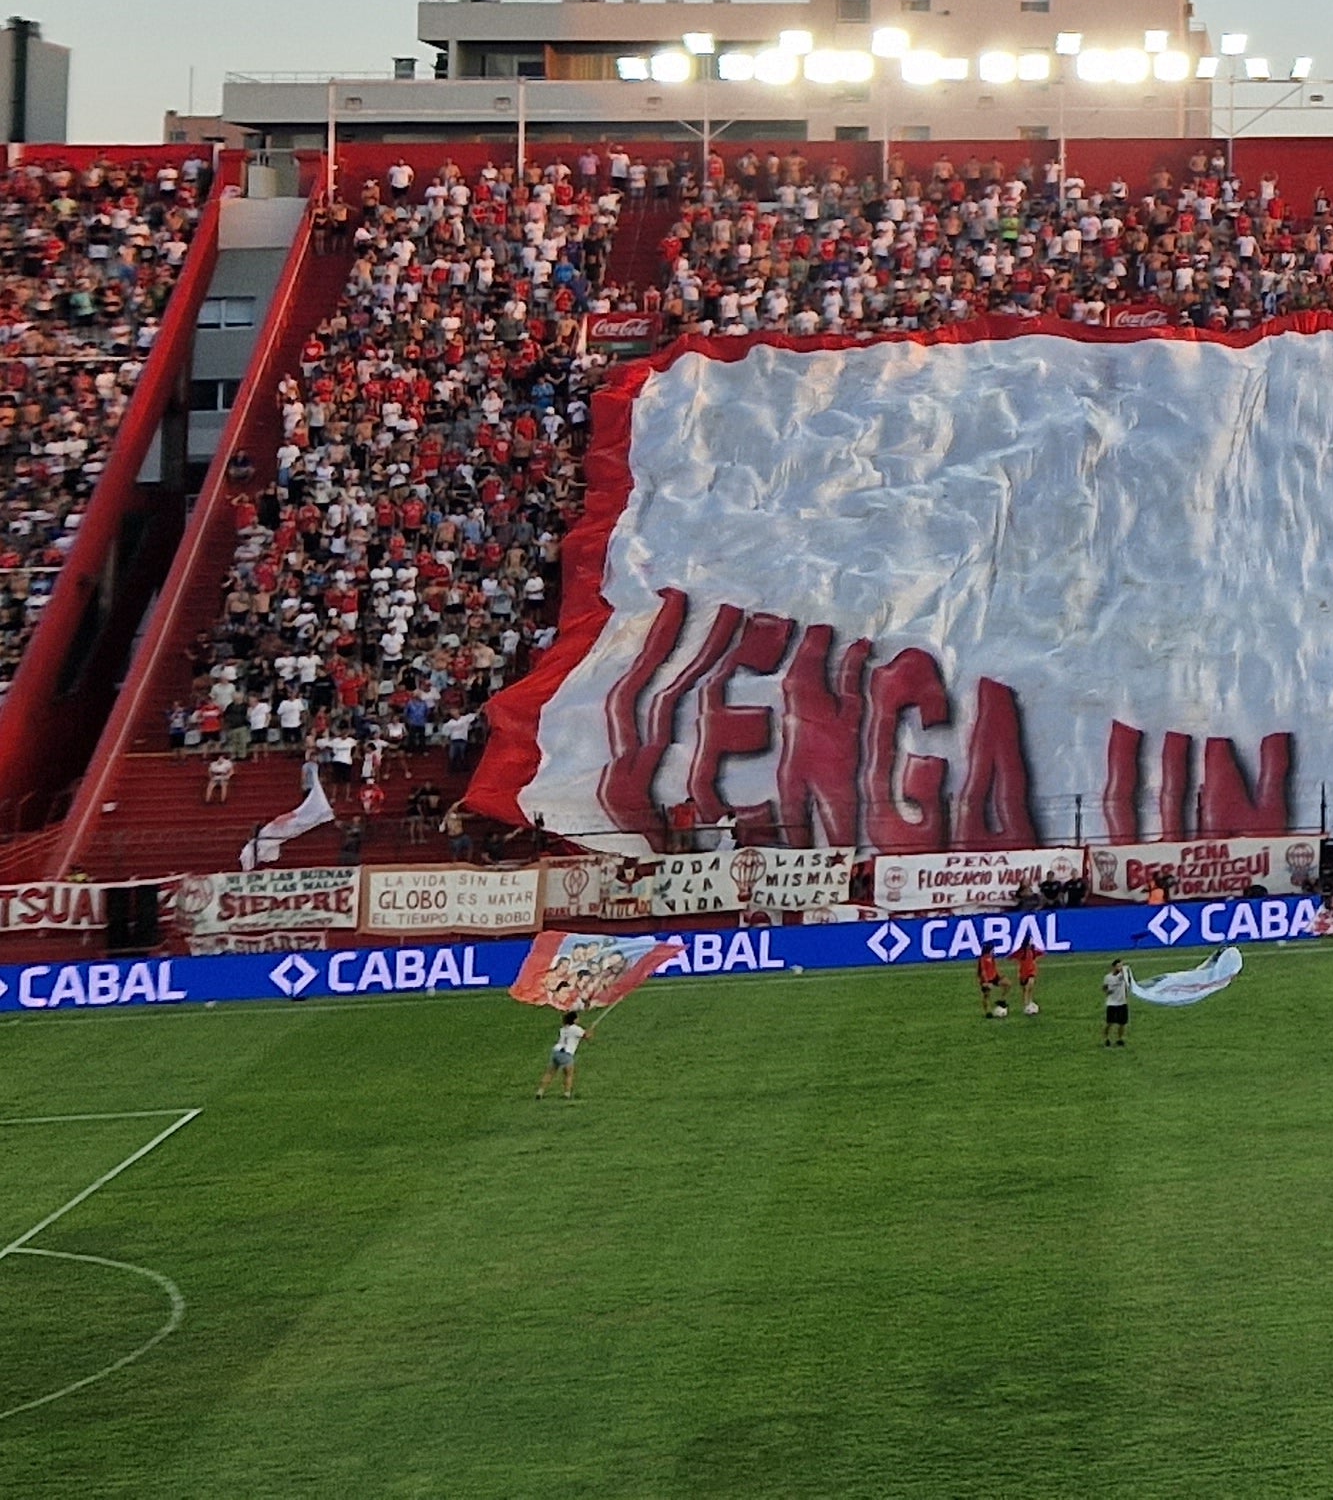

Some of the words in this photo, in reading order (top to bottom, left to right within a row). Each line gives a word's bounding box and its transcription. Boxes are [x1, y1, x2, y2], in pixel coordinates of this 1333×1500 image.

[598, 586, 1037, 852] VENGA
[945, 852, 1009, 868] PEÑA
[384, 876, 404, 888] LA
[412, 874, 447, 887] VIDA
[457, 873, 488, 887] SIN
[500, 874, 521, 886] EL
[765, 871, 848, 889] MISMAS
[918, 869, 992, 891] FLORENCIO
[217, 885, 355, 922] SIEMPRE
[378, 889, 448, 911] GLOBO
[456, 893, 478, 907] ES
[488, 890, 533, 907] MATAR
[371, 913, 391, 926] EL
[398, 912, 449, 925] TIEMPO
[922, 913, 1071, 959] CABAL
[1201, 899, 1324, 942] CABA
[328, 945, 489, 992] CABAL
[654, 930, 784, 974] ABAL
[19, 960, 188, 1008] CABAL
